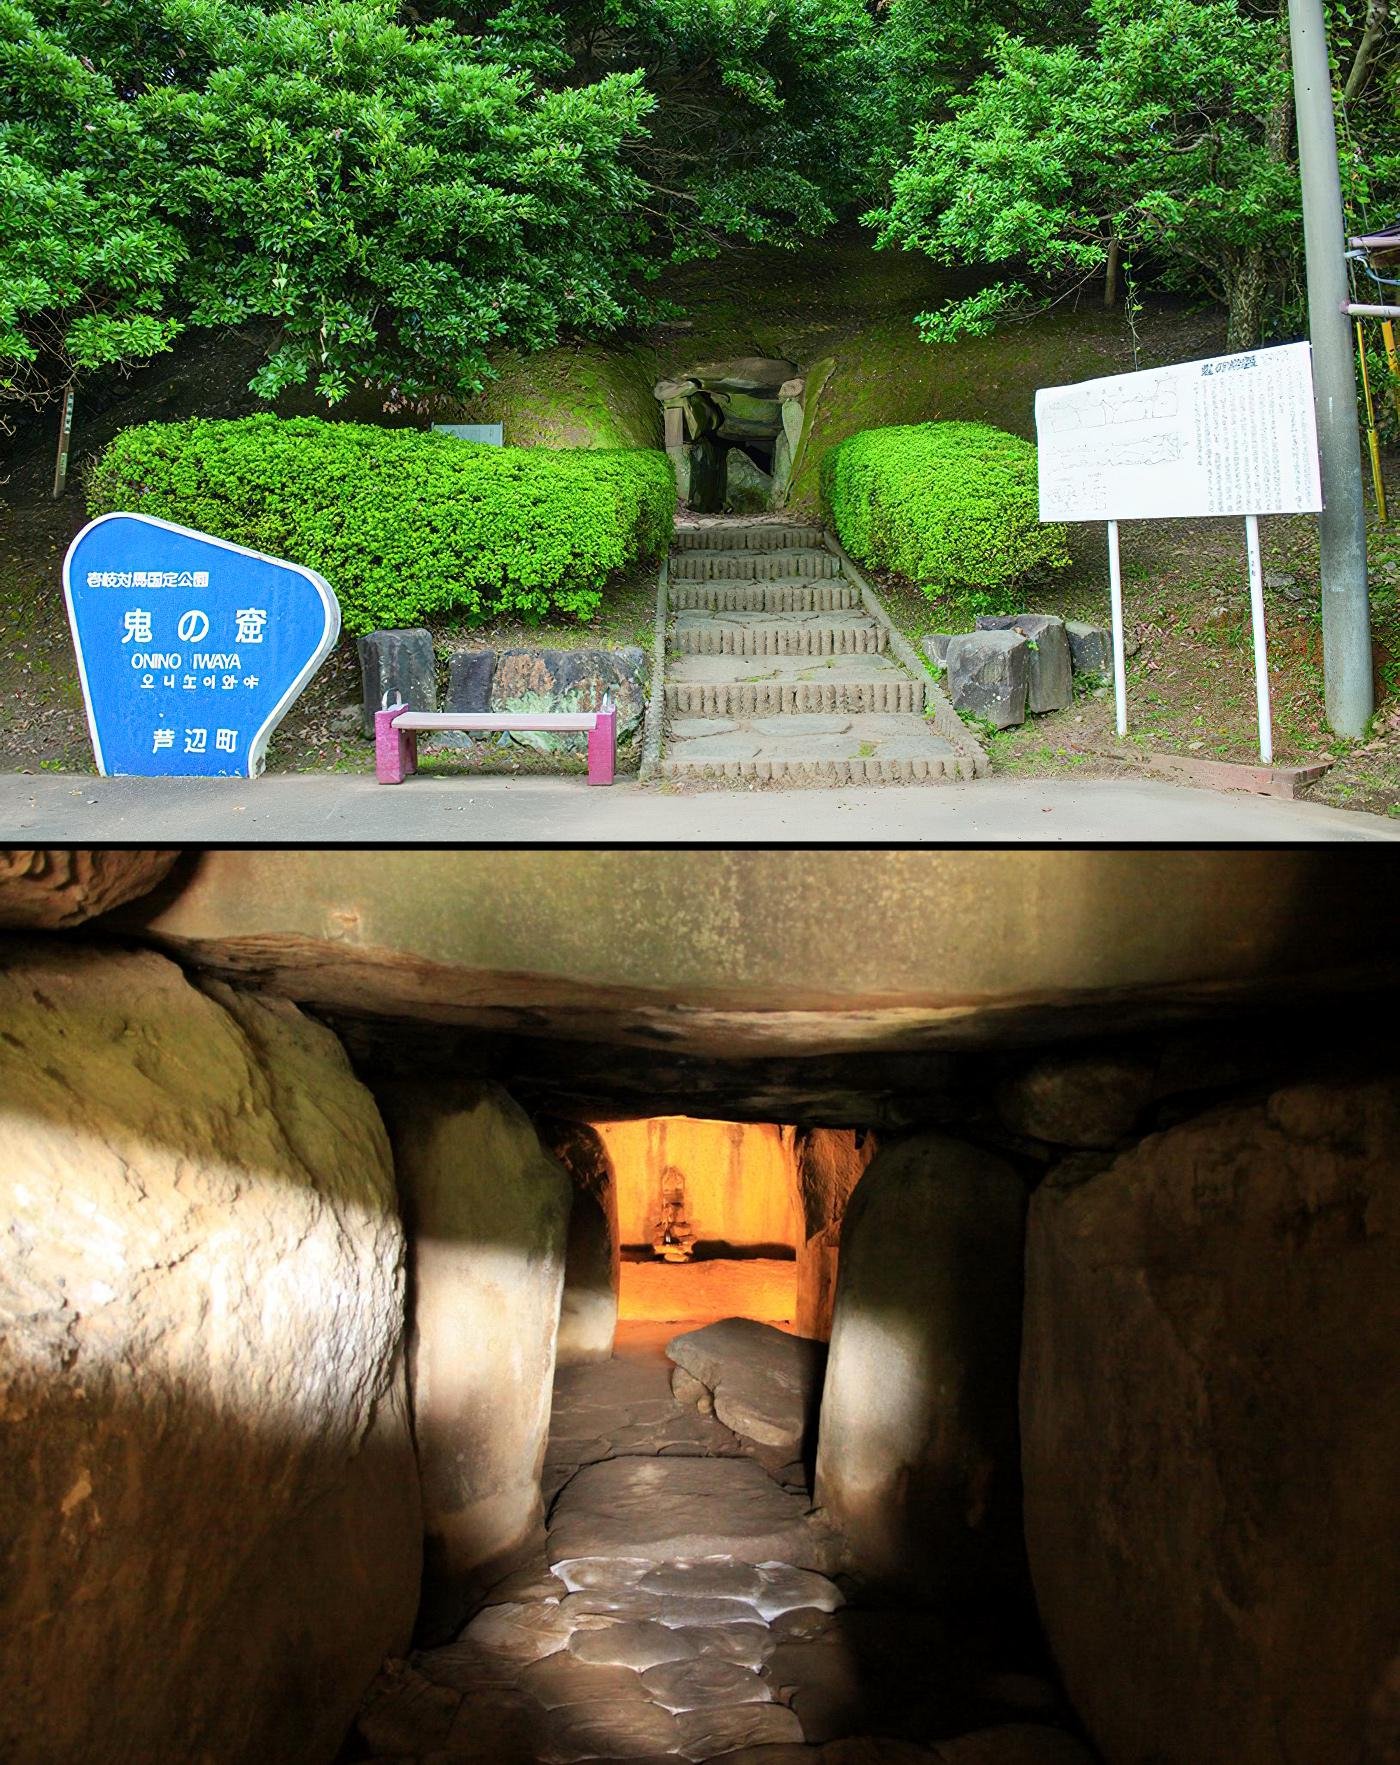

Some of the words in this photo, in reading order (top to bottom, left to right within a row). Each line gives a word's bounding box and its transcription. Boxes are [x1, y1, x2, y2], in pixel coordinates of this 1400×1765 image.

[122, 607, 267, 644] 鬼の窟
[131, 653, 182, 669] ONINO
[193, 653, 241, 669] IWAYA
[152, 728, 238, 754] 芦辺町
